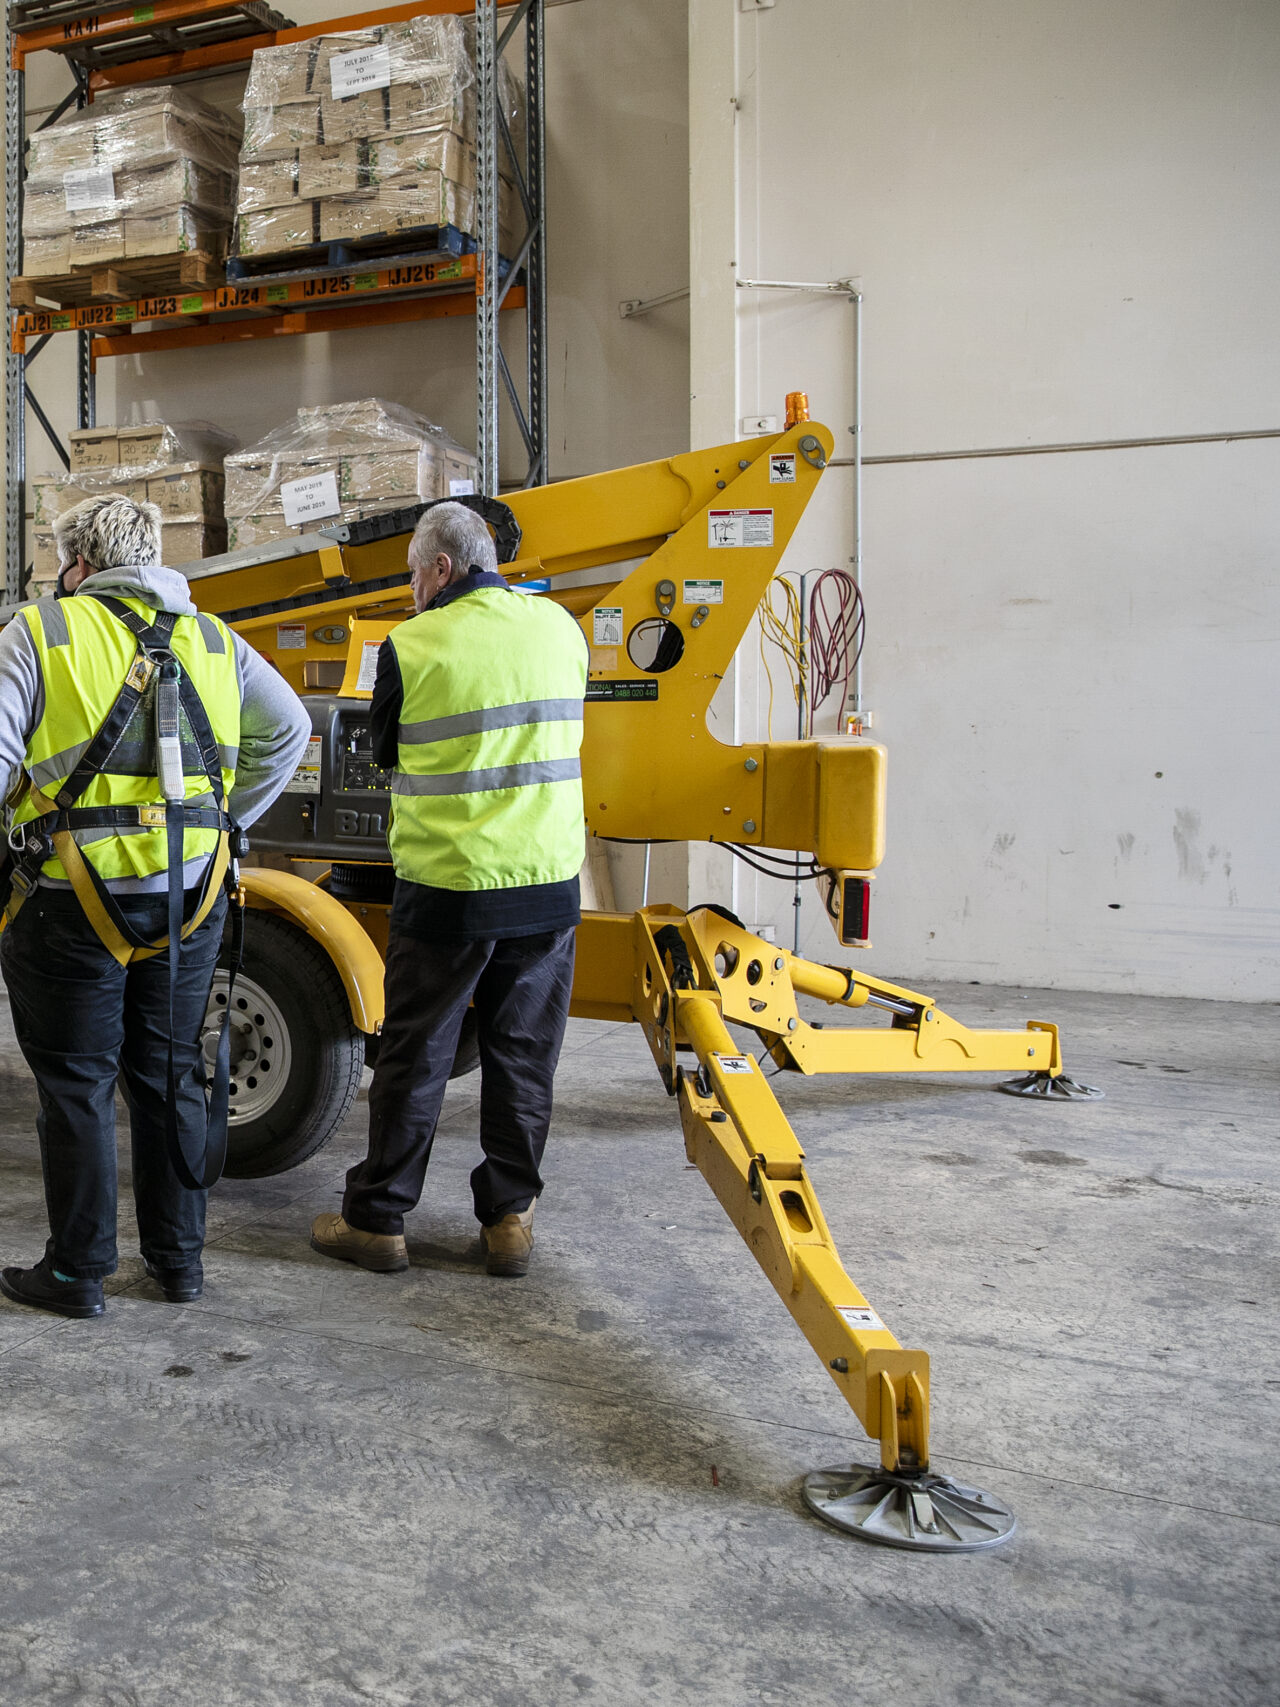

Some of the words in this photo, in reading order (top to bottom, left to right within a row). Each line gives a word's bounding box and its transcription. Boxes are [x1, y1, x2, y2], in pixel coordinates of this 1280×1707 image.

[344, 57, 358, 67] JULY
[355, 67, 365, 75] TO
[391, 264, 435, 286] JJ26
[218, 287, 260, 308] JJ24
[140, 297, 177, 317] JJ23
[20, 315, 50, 333] JJ21
[294, 485, 307, 493] MAY
[305, 493, 314, 501] TO
[297, 504, 311, 513] JUNE
[587, 683, 612, 691] TIONAL
